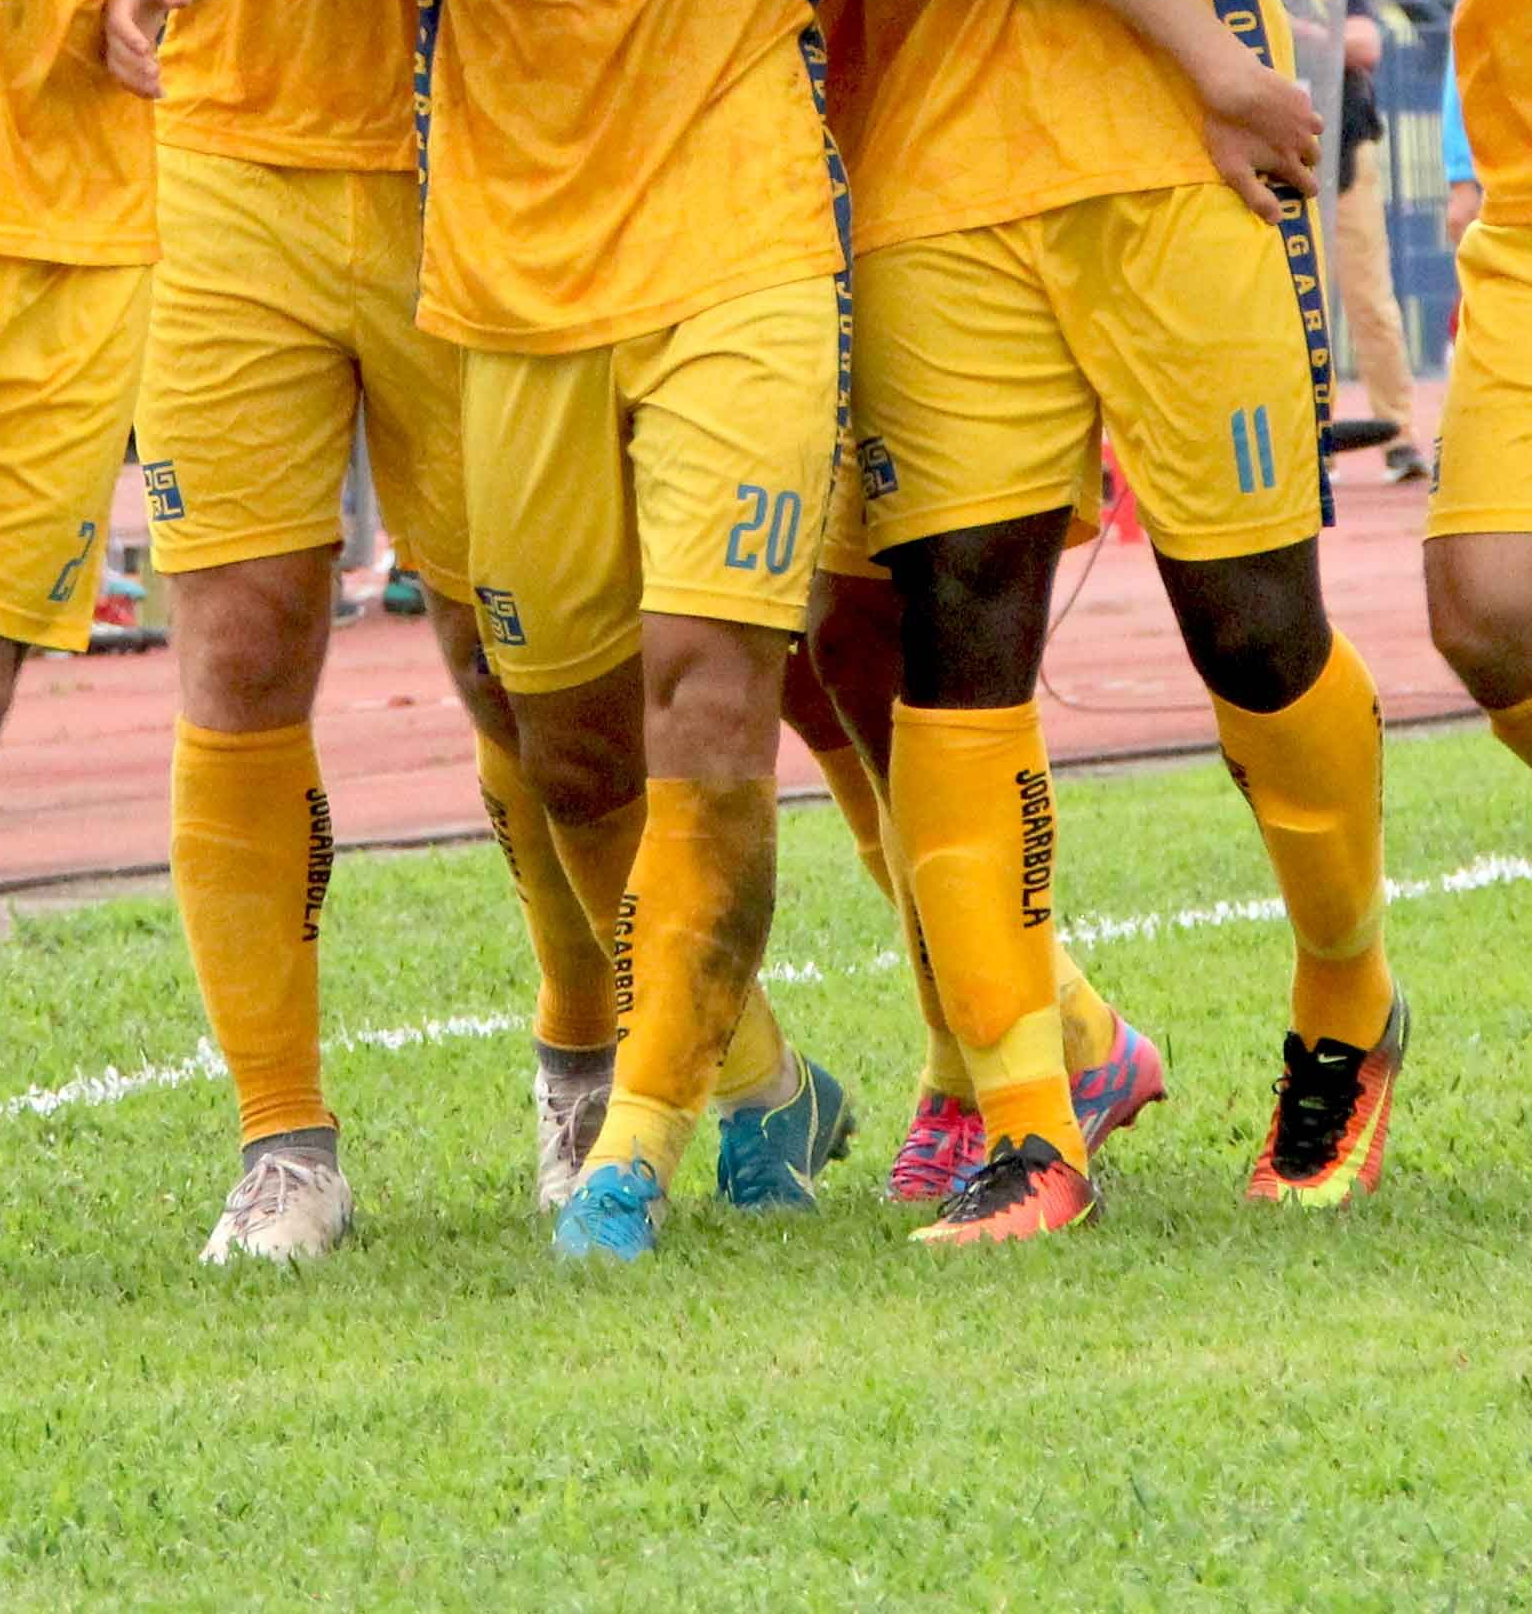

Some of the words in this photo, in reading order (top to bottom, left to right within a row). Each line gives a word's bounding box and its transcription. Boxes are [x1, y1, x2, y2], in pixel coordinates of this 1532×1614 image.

[1230, 406, 1275, 494] 11
[725, 484, 801, 574] 20
[302, 788, 334, 942] JOGARBOLA
[1015, 769, 1054, 928] JOGARBOLA
